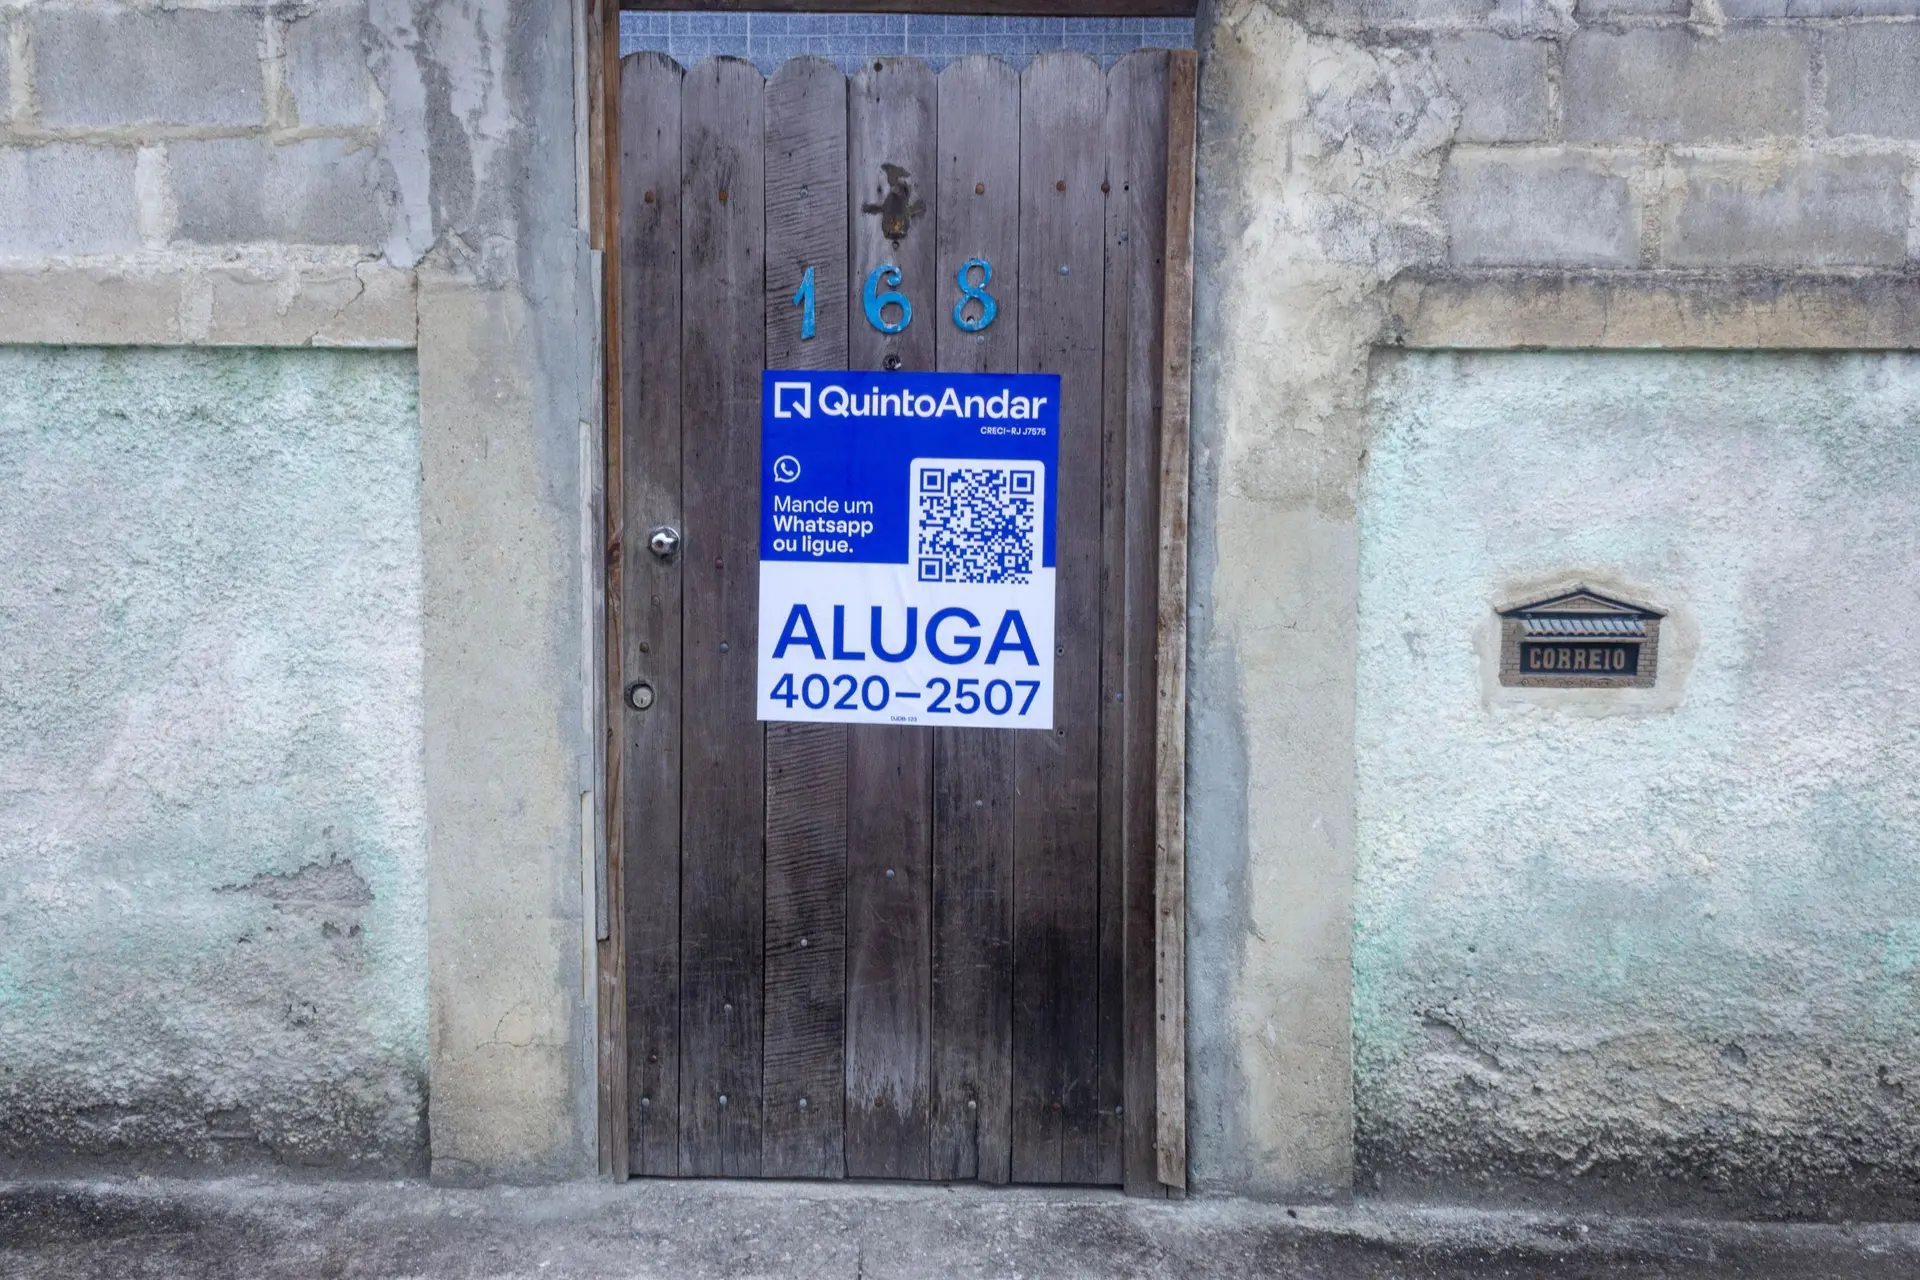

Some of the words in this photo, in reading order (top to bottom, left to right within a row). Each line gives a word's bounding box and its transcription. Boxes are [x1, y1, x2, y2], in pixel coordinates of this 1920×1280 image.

[818, 385, 1047, 420] QuintoAndar
[980, 426, 1022, 436] CRECI-RJ
[1022, 427, 1047, 436] J7575
[774, 495, 840, 514] Mande
[843, 500, 874, 515] um
[773, 515, 874, 538] Whatsapp
[773, 538, 797, 552] ou
[802, 535, 854, 557] ligue.
[771, 603, 1040, 667] ALUGA
[1529, 647, 1626, 671] CORREIO
[769, 673, 1041, 716] 4020-2507
